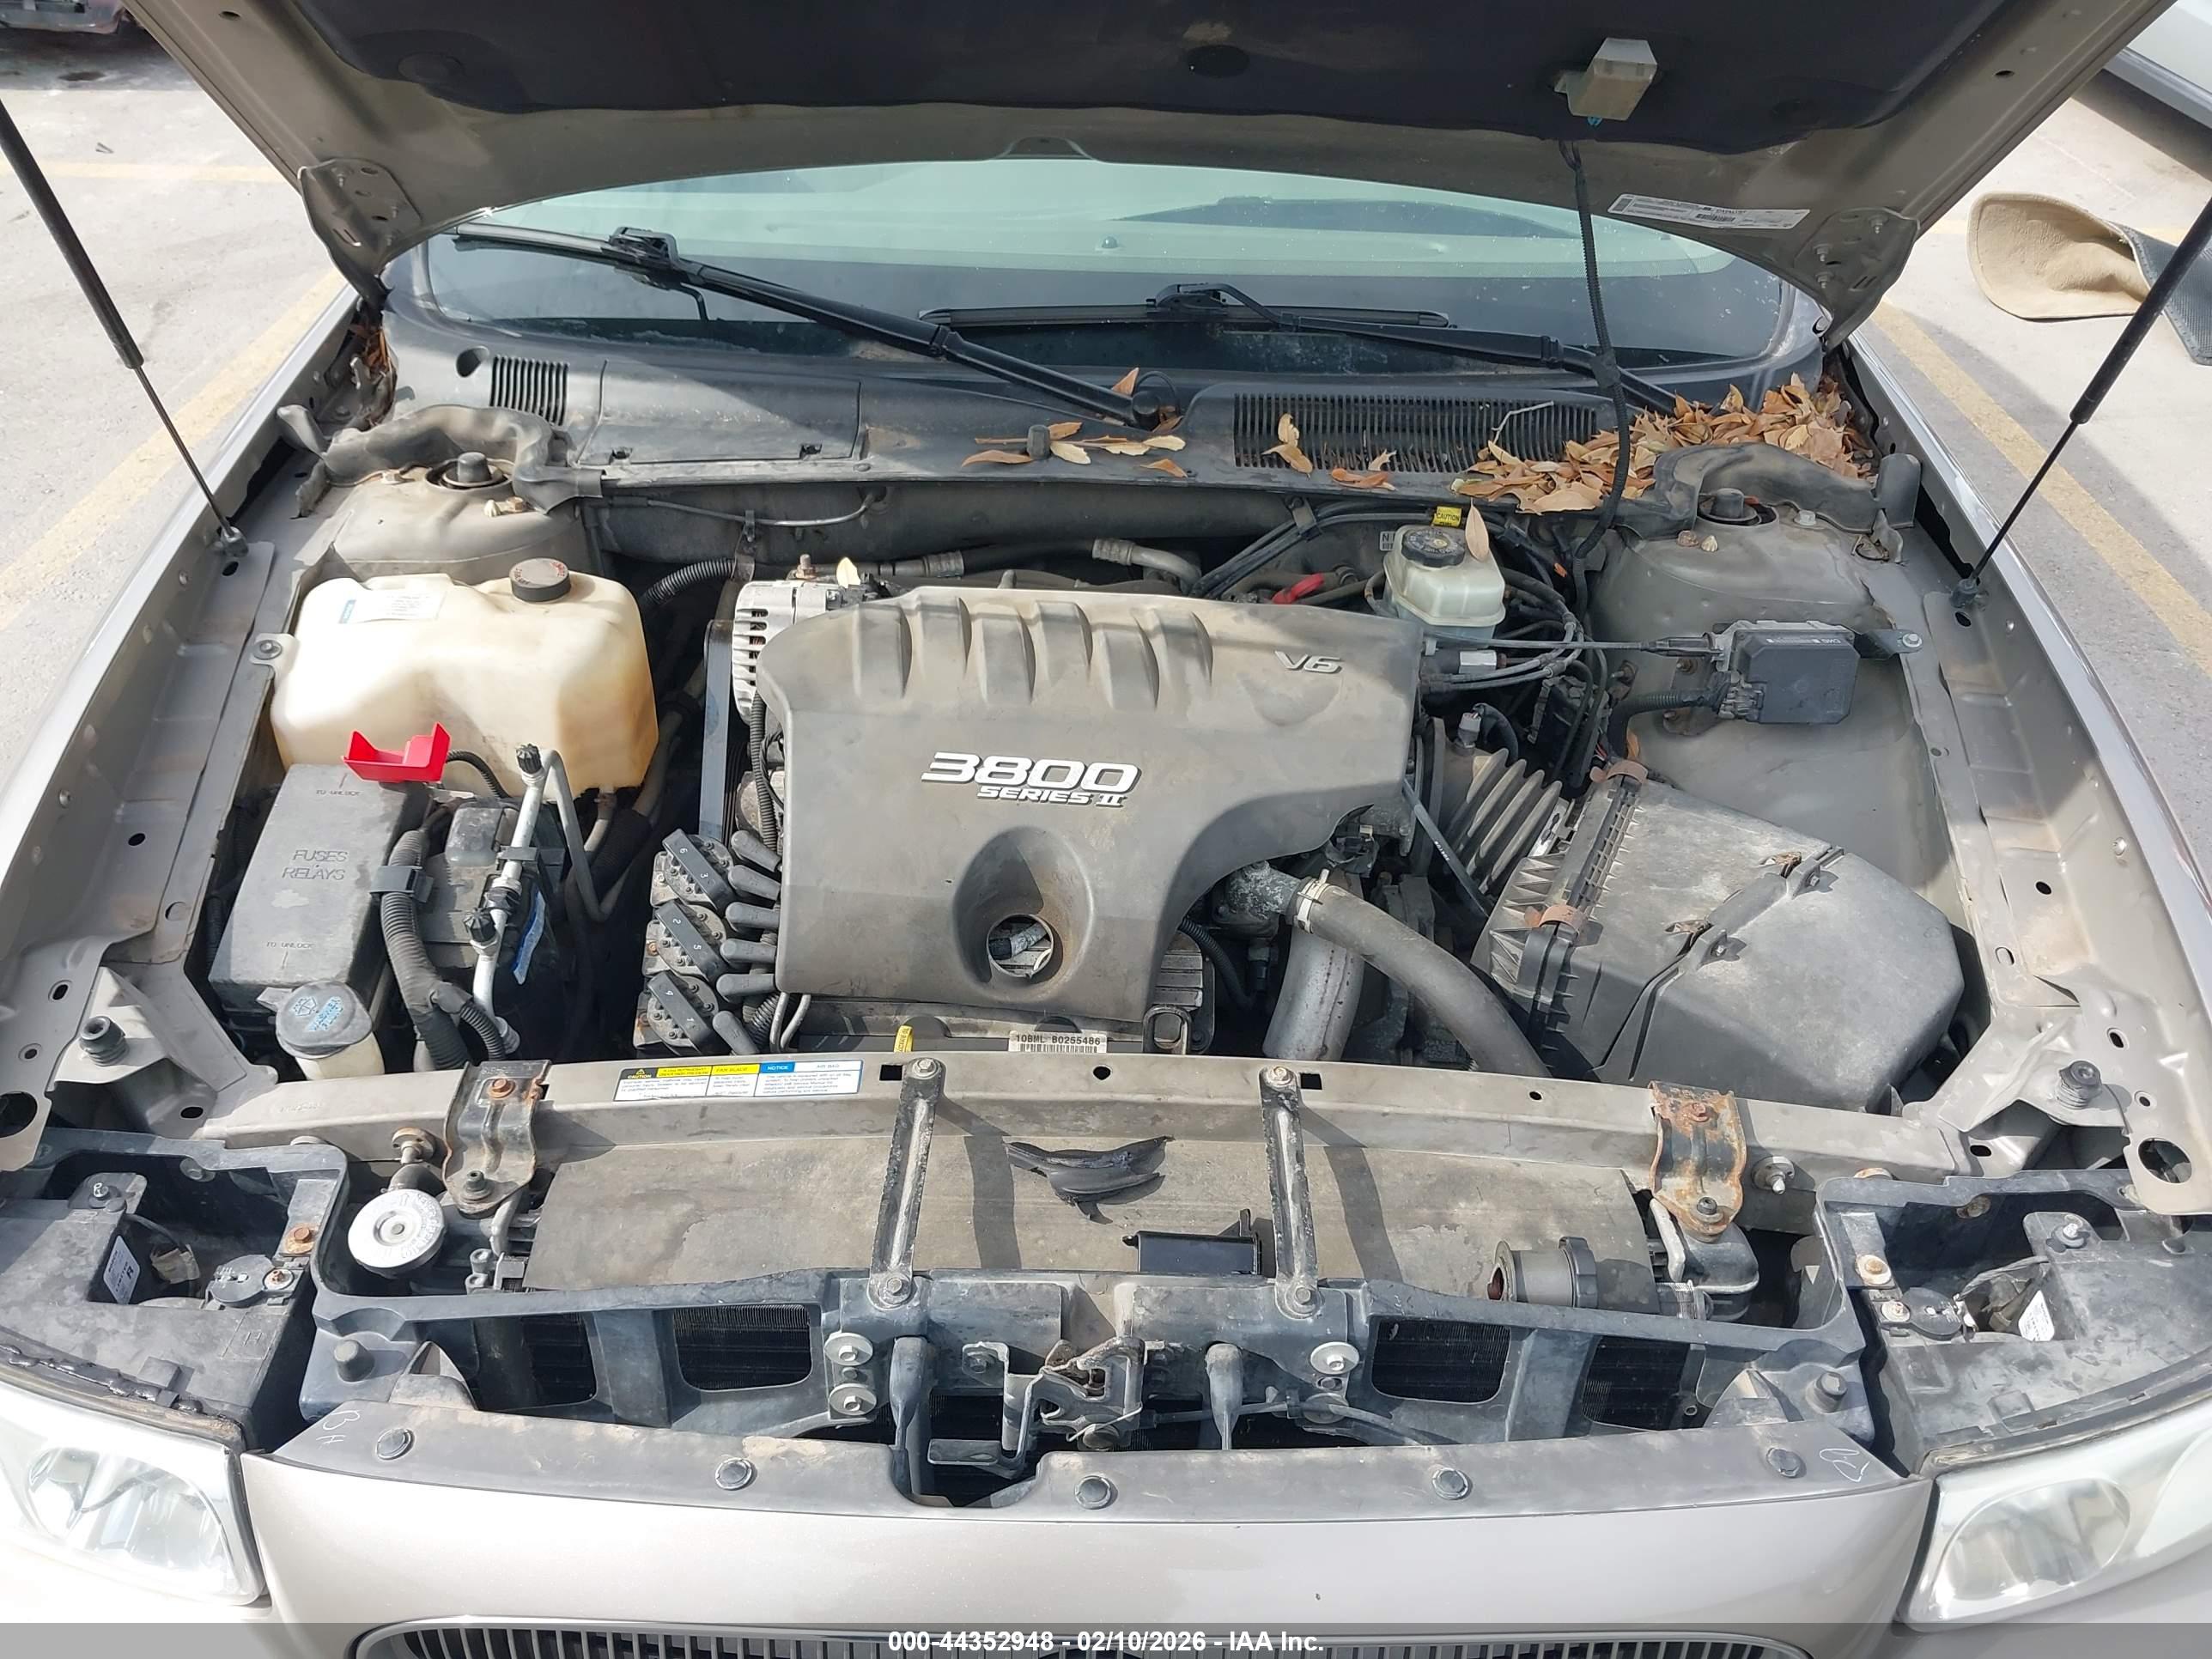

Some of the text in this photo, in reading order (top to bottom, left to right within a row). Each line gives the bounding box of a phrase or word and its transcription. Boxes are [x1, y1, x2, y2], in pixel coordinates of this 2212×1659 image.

[1437, 513, 1460, 521] CAUTION
[1274, 651, 1344, 674] V6
[921, 751, 1143, 793] 3800
[976, 786, 1128, 808] SERIES II
[292, 849, 349, 862] FUSES
[282, 867, 346, 880] RELAYS
[1015, 1034, 1101, 1045] 10BML B0255486
